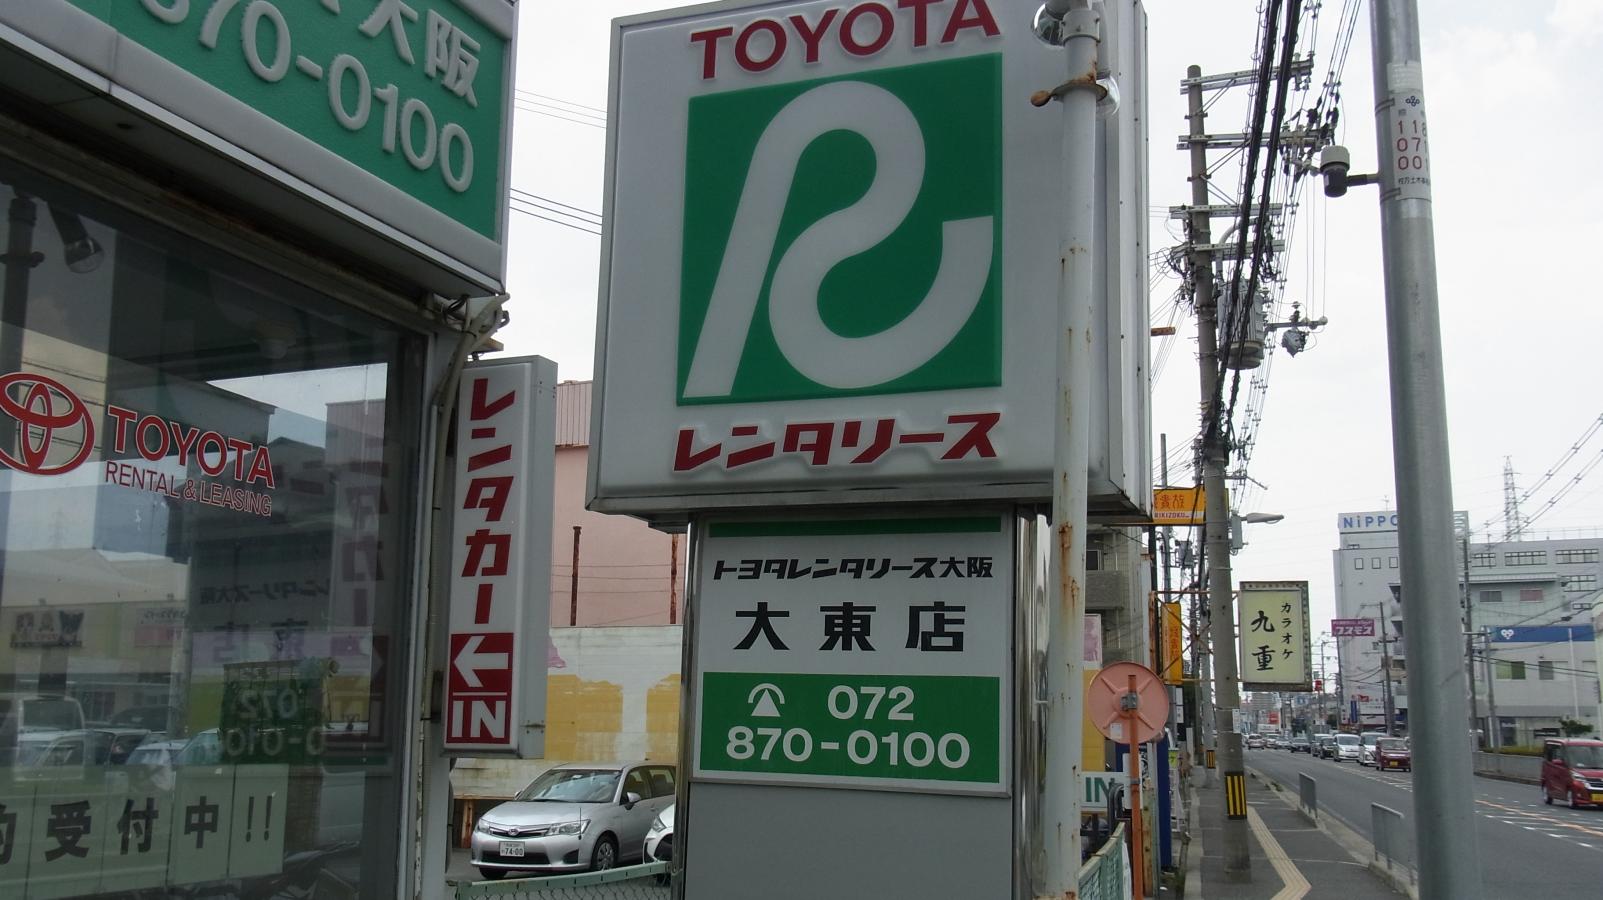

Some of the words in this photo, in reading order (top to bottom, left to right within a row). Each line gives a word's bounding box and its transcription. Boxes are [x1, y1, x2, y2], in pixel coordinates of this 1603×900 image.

[691, 0, 1001, 80] TOYOTA
[108, 404, 275, 488] TOYOTA
[673, 412, 1001, 471] レンタリース
[105, 460, 180, 498] RENTAL
[183, 479, 197, 501] &
[199, 481, 272, 517] LEASING
[461, 378, 516, 624] レンタカー
[713, 556, 993, 580] トヨタレンタリース大阪
[733, 601, 966, 652] 大東店
[1250, 610, 1276, 671] 九重
[1281, 602, 1294, 660] カラオケ
[452, 700, 507, 738] IN
[827, 685, 915, 721] 072
[726, 725, 971, 769] 870-0100
